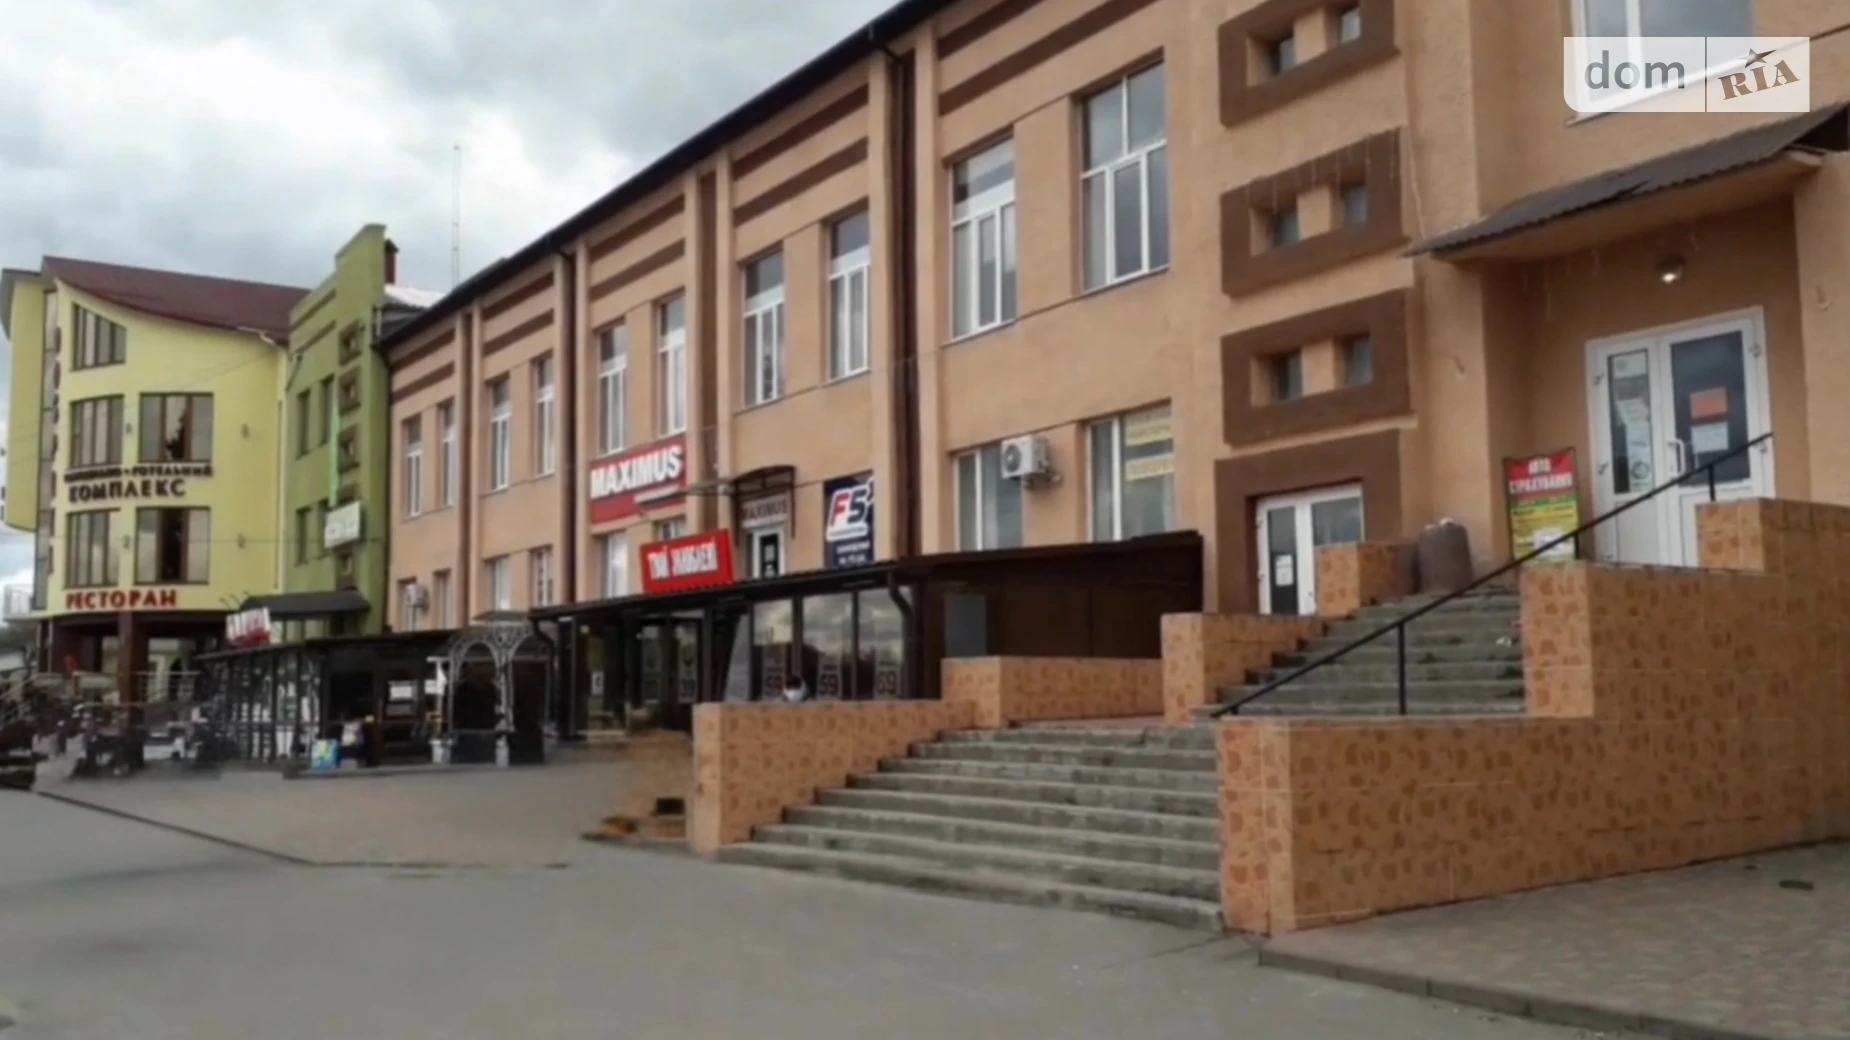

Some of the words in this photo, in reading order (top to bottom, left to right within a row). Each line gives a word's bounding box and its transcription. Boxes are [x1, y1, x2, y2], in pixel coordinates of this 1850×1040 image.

[591, 444, 682, 499] MAXIMUS
[69, 479, 186, 502] КОМПЛЕКС
[66, 589, 177, 610] РЕСТОРАН
